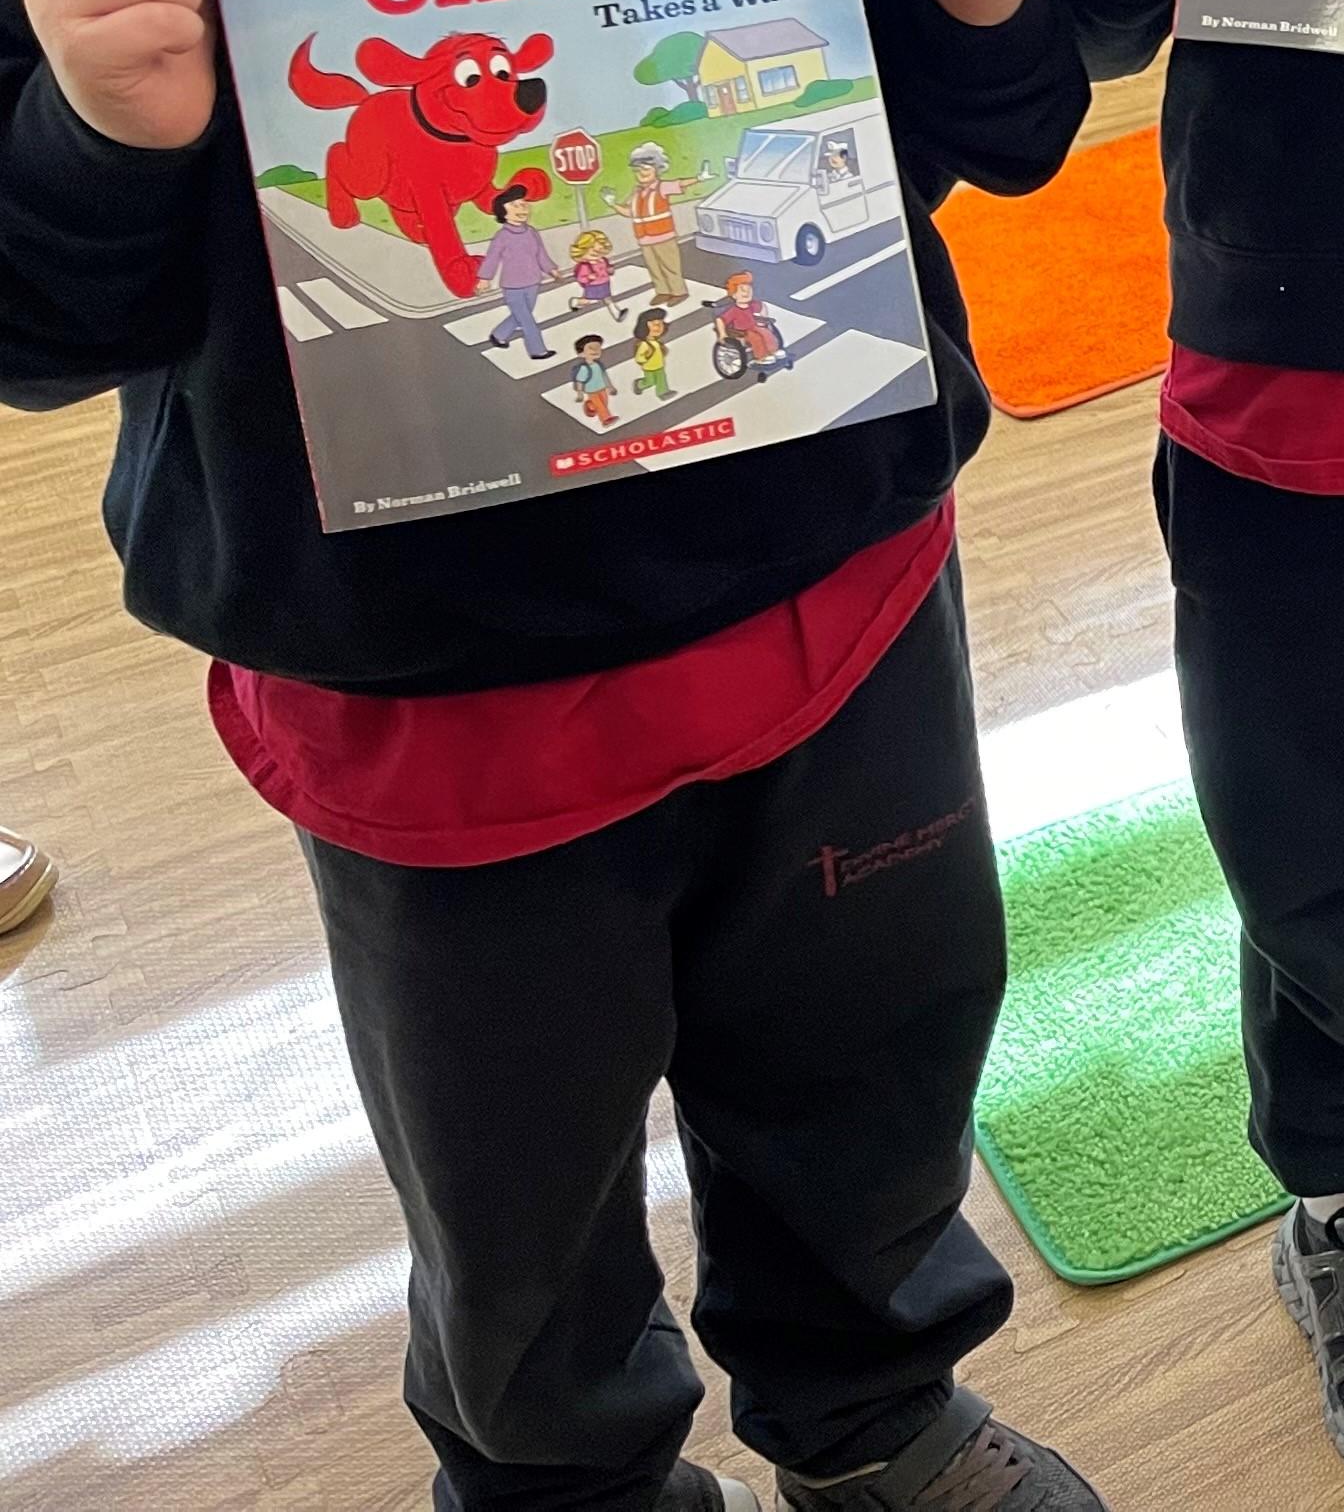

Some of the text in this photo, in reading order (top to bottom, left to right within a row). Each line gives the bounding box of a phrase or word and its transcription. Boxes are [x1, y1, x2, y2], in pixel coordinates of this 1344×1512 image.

[1201, 15, 1337, 37] By Norman Bridwell
[554, 145, 597, 173] STOP
[578, 420, 733, 467] SCHOLASTIC
[353, 473, 522, 514] By Norman Bridwell
